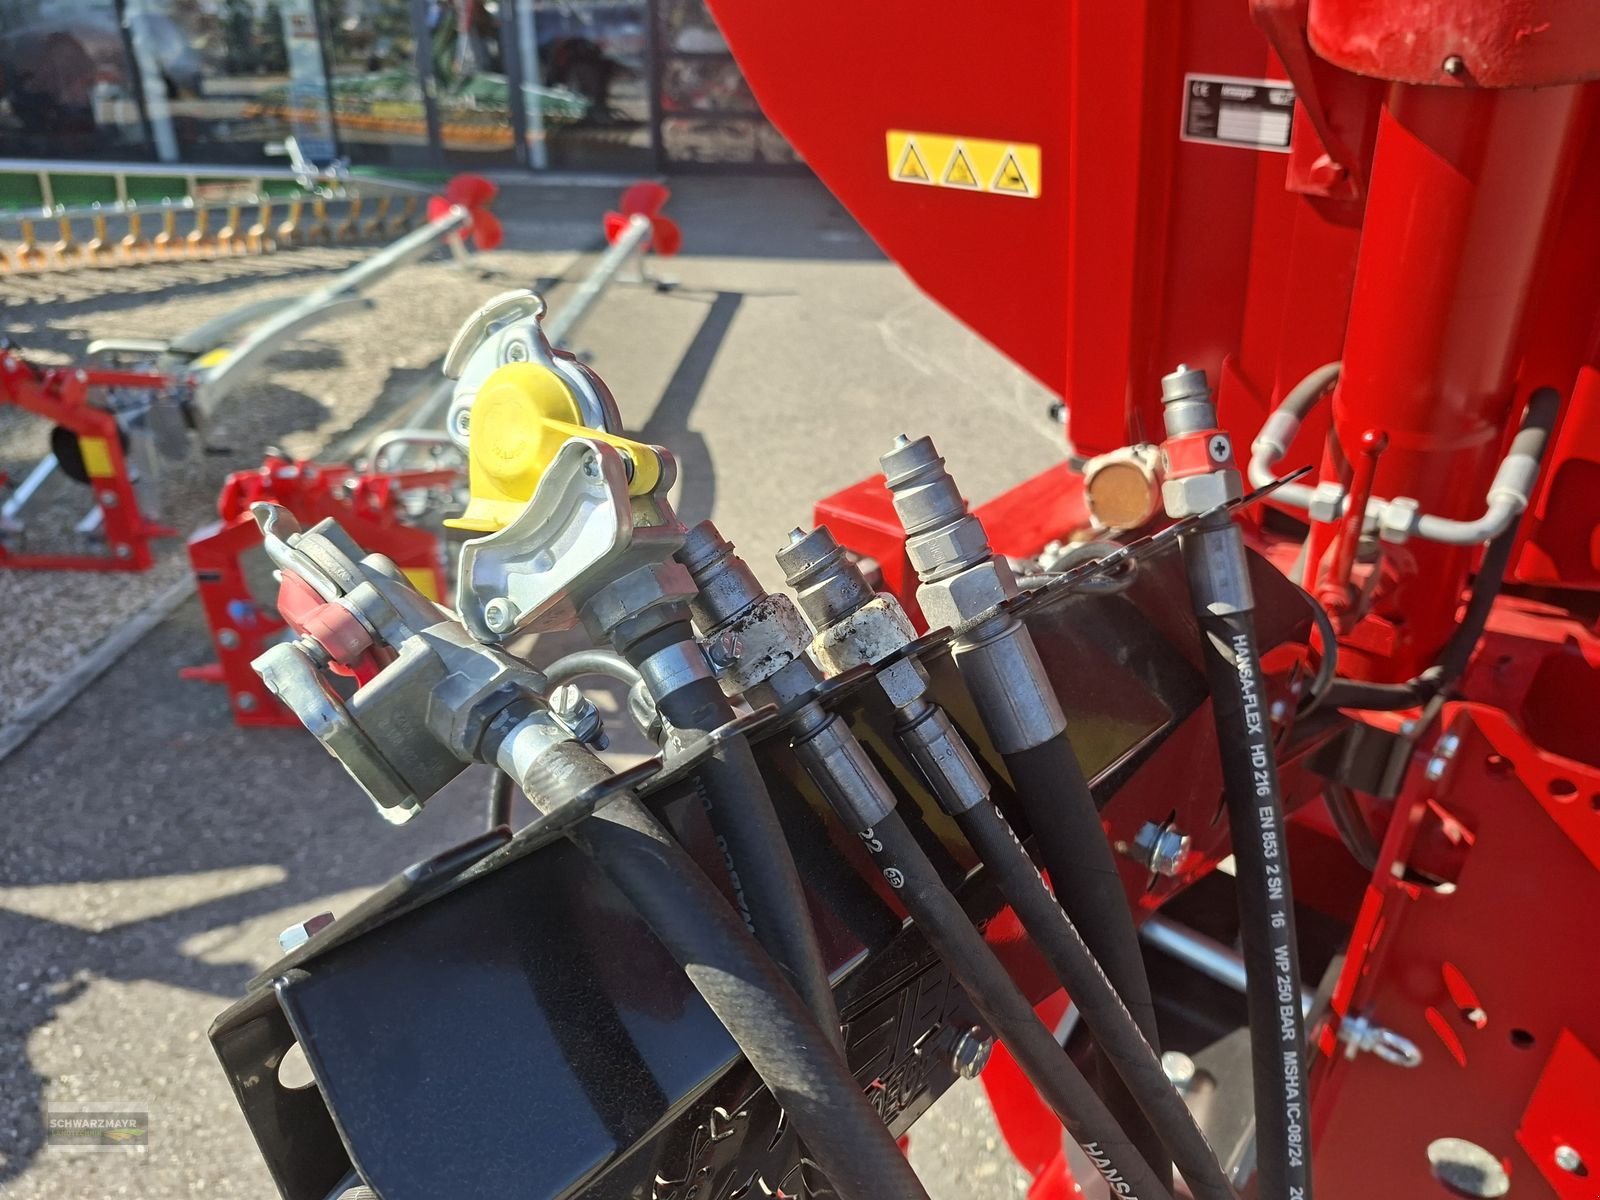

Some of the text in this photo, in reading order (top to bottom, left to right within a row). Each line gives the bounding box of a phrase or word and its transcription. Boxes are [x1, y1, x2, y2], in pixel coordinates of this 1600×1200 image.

[1232, 634, 1262, 734] HANSA-FLEX
[1250, 744, 1267, 768] HD
[1253, 770, 1270, 797] 216
[1258, 805, 1275, 830] EN
[1261, 831, 1278, 859] 853
[1265, 865, 1280, 875] 2
[1268, 879, 1283, 900] SN
[1270, 910, 1285, 928] 16
[1273, 944, 1290, 973] WP
[1276, 974, 1293, 1002] 250
[1278, 1004, 1296, 1042] BAR
[1283, 1051, 1299, 1101] MSHA
[1286, 1102, 1303, 1168] IC-08/24
